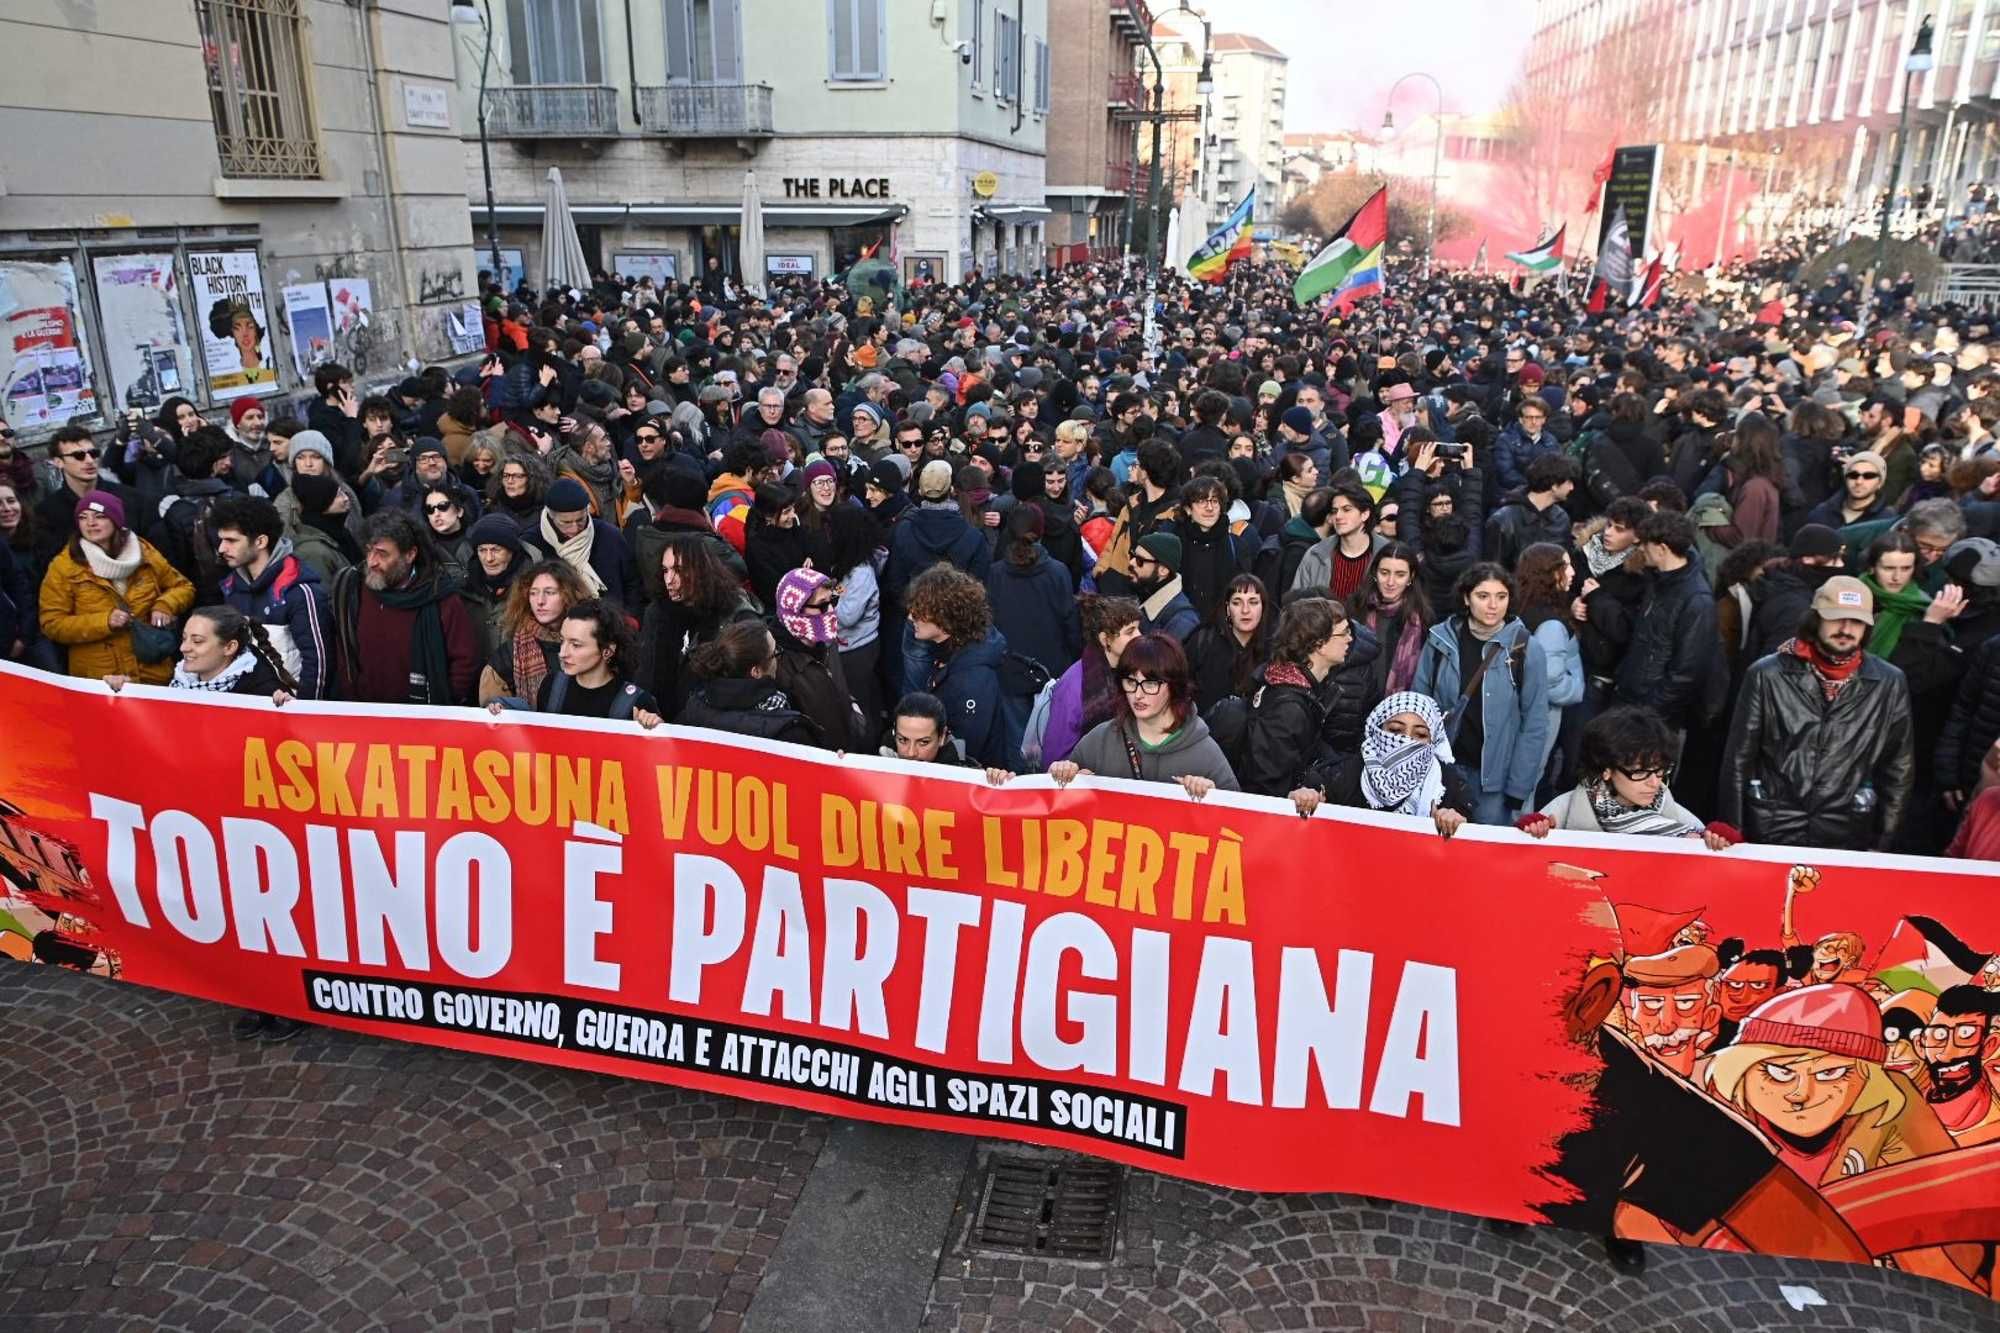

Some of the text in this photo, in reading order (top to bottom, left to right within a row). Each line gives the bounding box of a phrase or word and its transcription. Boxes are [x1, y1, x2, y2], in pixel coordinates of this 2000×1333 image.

[783, 178, 889, 198] THE PLACE
[190, 256, 225, 275] BLACK
[207, 274, 248, 295] HISTORY
[227, 291, 262, 309] MONTH
[243, 737, 1246, 925] ASKATASUNA VUOL DIRE LIBERTÀ
[89, 793, 1461, 1127] TORINO È PARTIGIANA
[312, 977, 1176, 1150] CONTRO GOVERNO, GUERRA E ATTACCHI AGLI SPAZI SOCIALI
